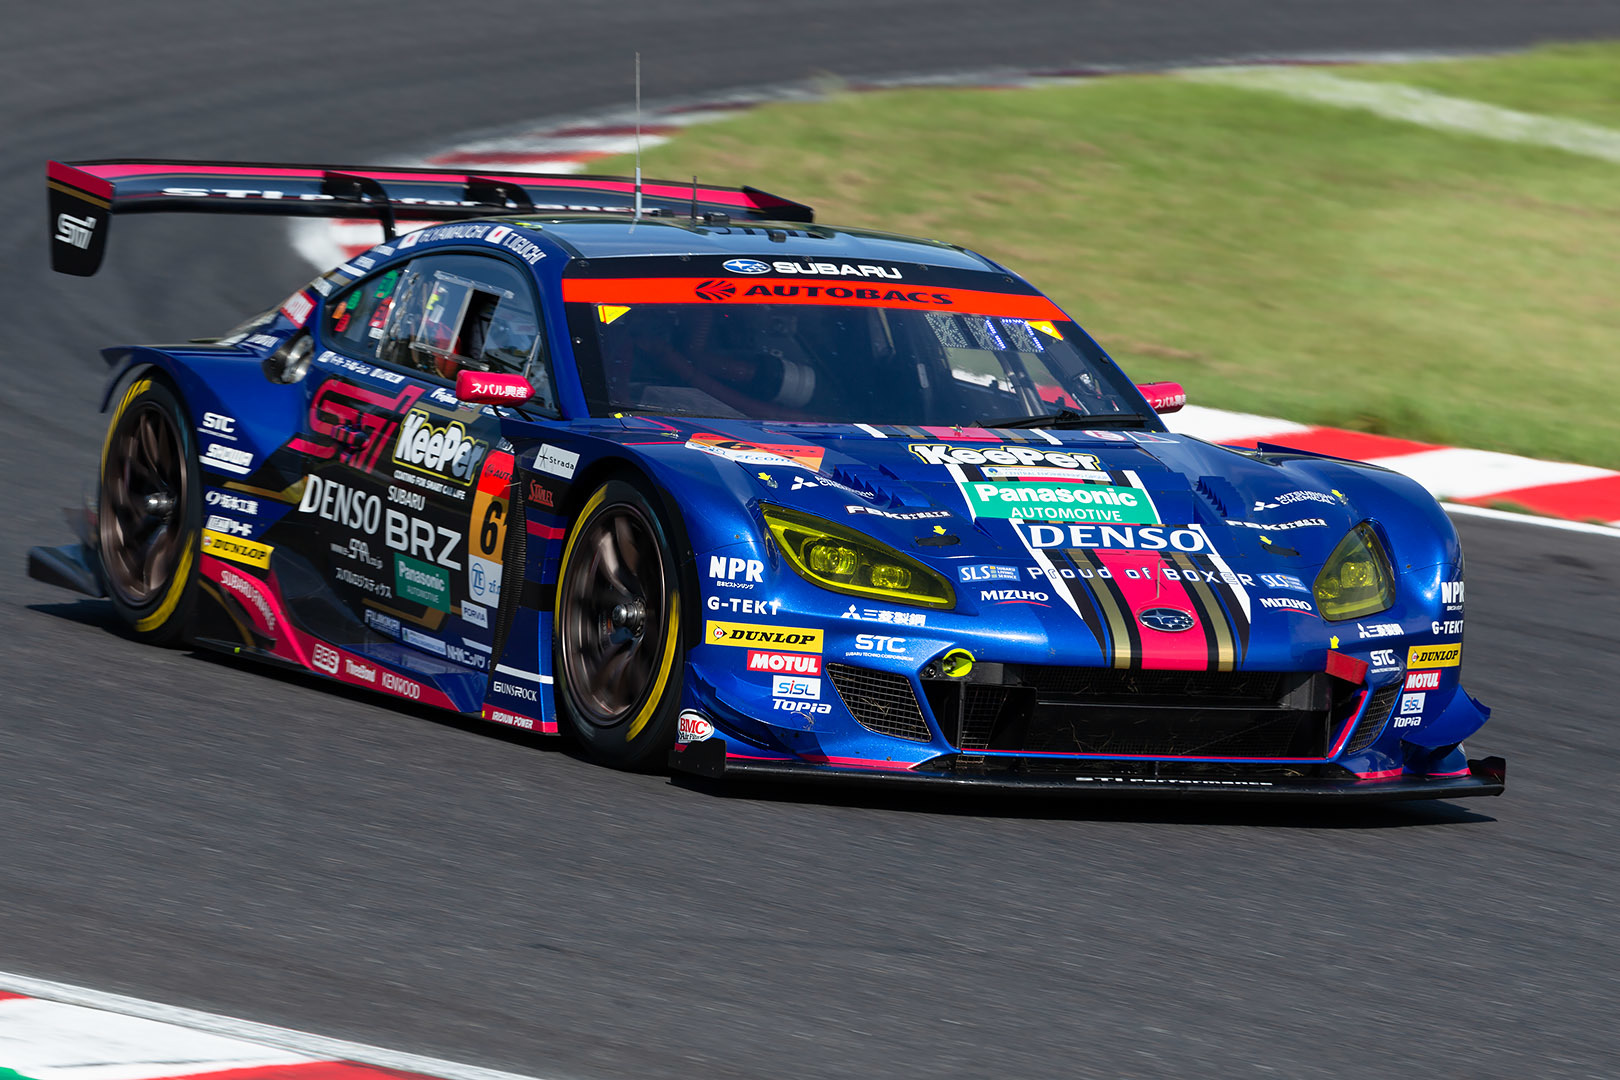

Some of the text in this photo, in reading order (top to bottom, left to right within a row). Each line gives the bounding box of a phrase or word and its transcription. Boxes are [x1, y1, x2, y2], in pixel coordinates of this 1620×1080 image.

[772, 259, 903, 280] SUBARU
[744, 284, 954, 306] AUTOBACS
[470, 383, 528, 398] スバル興産
[202, 411, 236, 433] STC
[394, 410, 486, 482] KeePer
[548, 456, 575, 471] Strada
[915, 444, 1098, 471] KeePer
[298, 473, 381, 535] DENSO
[387, 485, 426, 512] SUBARU
[974, 483, 1138, 507] Panasonic
[1010, 506, 1123, 522] AUTOMOTIVE
[480, 500, 507, 556] 6
[1028, 524, 1205, 552] DENSO
[212, 538, 268, 560] DUNLOP
[385, 508, 462, 571] BRZ
[398, 560, 446, 592] Panasonic
[708, 555, 765, 583] NPR
[960, 565, 991, 581] SLS
[1026, 566, 1257, 588] Proud of BOXER
[1260, 574, 1289, 588] SLS
[980, 589, 1049, 601] MIZUHO
[1441, 581, 1465, 604] NPR
[707, 596, 782, 616] G-TEKT
[1259, 597, 1312, 611] MIZUHO
[728, 628, 816, 646] DUNLOP
[1431, 619, 1464, 635] G-TEKT
[855, 633, 907, 653] STC
[750, 653, 819, 674] MOTUL
[1370, 649, 1396, 666] STC
[1419, 650, 1459, 662] DUNLOP
[381, 671, 421, 700] KENWOOD
[1405, 672, 1439, 689] MOTUL
[493, 681, 538, 702] GUNSROCK
[680, 717, 708, 735] BMC
